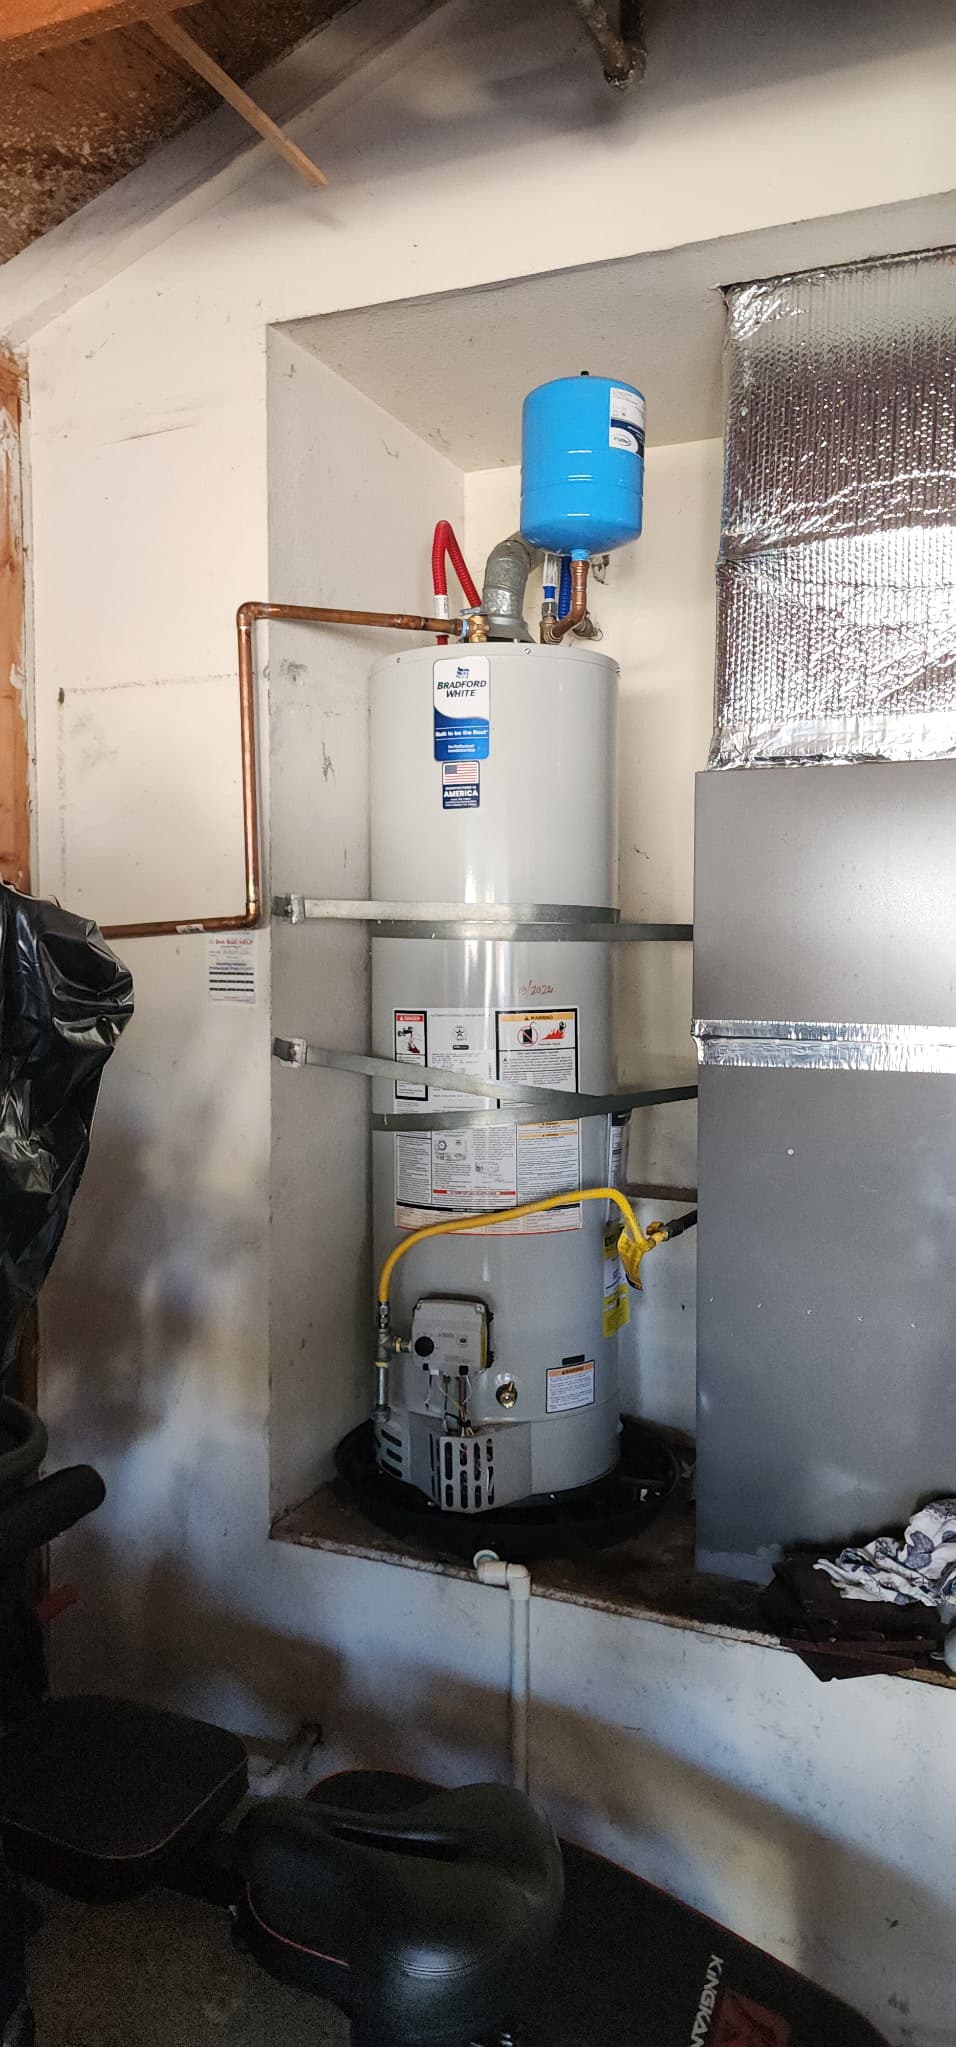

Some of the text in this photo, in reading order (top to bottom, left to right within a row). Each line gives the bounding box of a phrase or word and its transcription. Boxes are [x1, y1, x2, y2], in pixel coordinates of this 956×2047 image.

[437, 680, 487, 690] BRADFORD
[446, 689, 476, 698] WHITE
[443, 790, 478, 798] AMERICA
